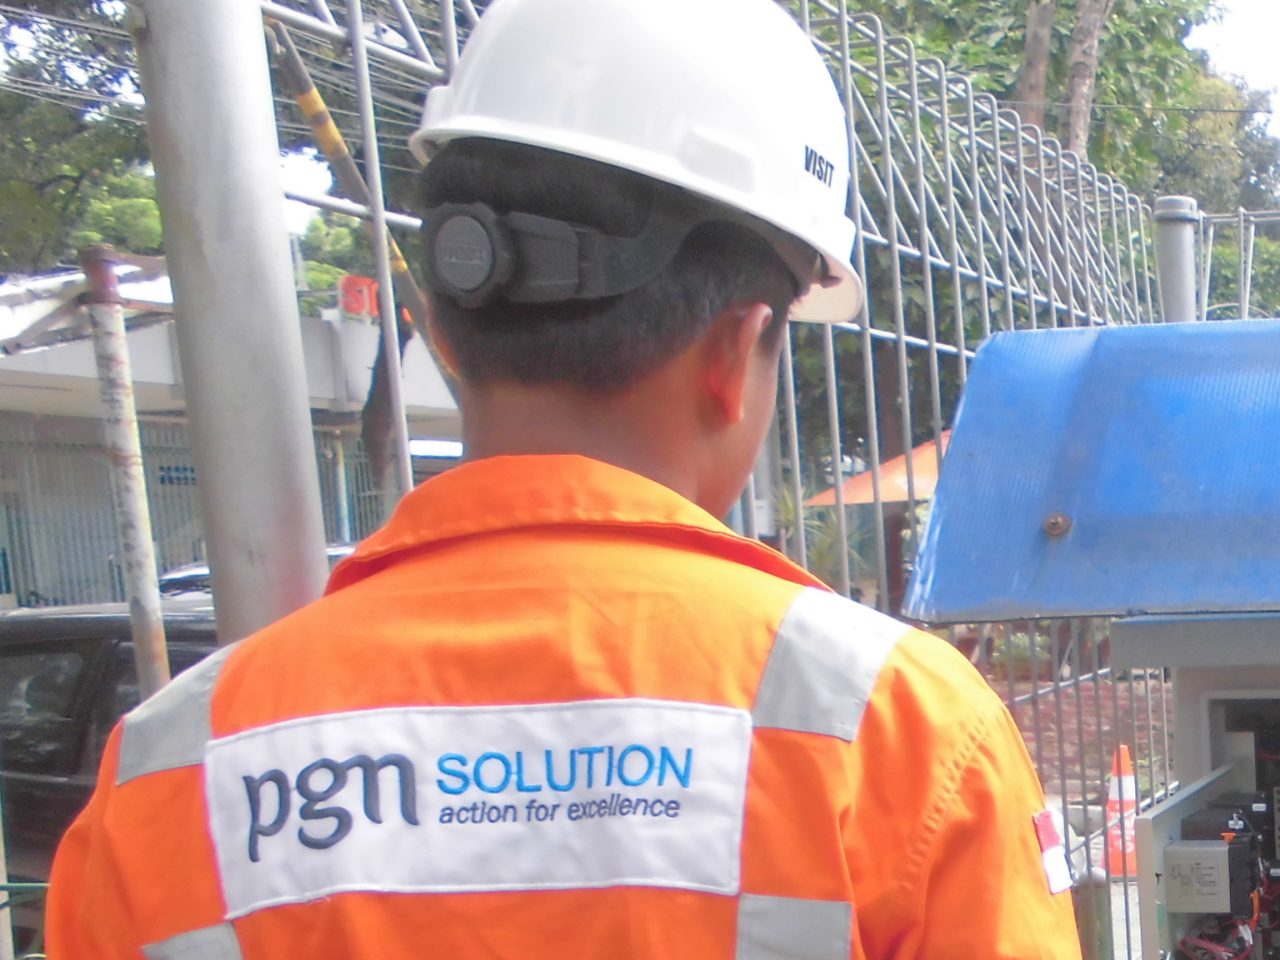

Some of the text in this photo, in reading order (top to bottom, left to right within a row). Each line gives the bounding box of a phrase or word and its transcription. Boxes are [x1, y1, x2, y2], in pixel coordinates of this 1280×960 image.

[803, 144, 835, 188] VISIT
[242, 744, 693, 863] pgn SOLUTION
[439, 793, 681, 824] action for excellence
